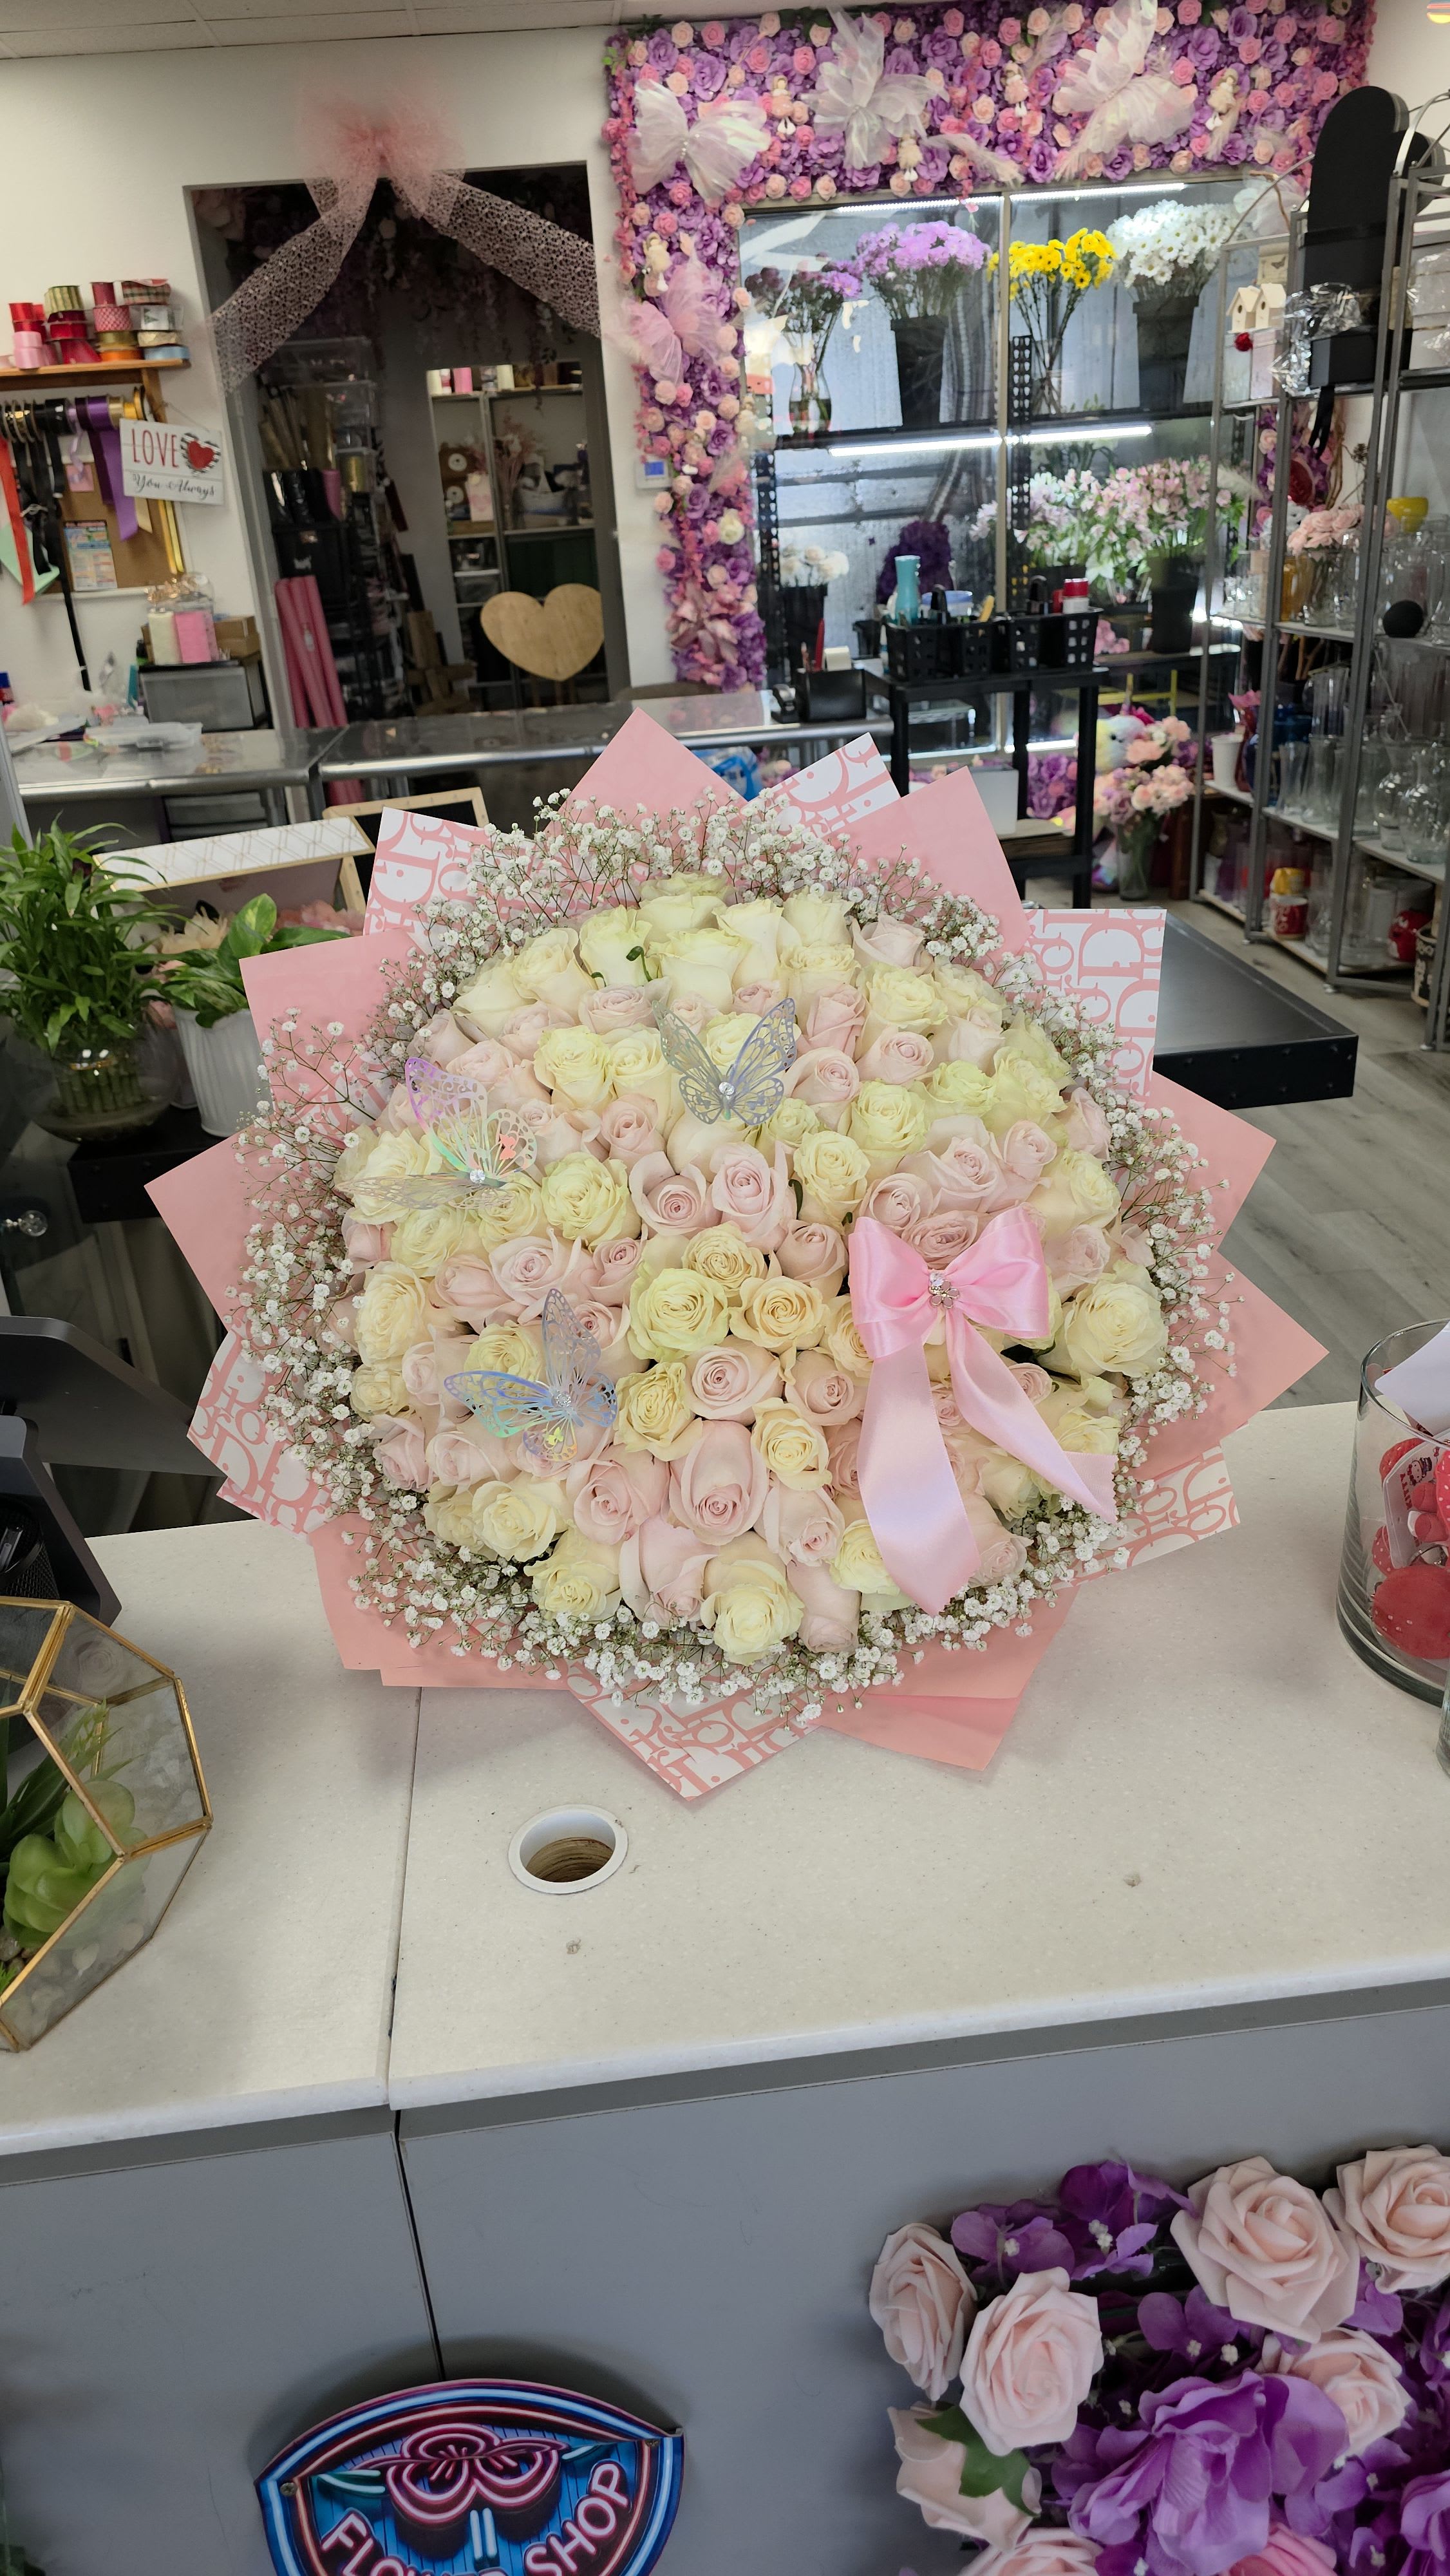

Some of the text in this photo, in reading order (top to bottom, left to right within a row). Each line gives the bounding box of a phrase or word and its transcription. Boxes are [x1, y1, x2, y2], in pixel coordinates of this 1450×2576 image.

[131, 428, 180, 468] LOVE
[133, 473, 215, 500] You Always
[1400, 1473, 1413, 1510] KITTY
[322, 2462, 629, 2576] FLO SHOP
